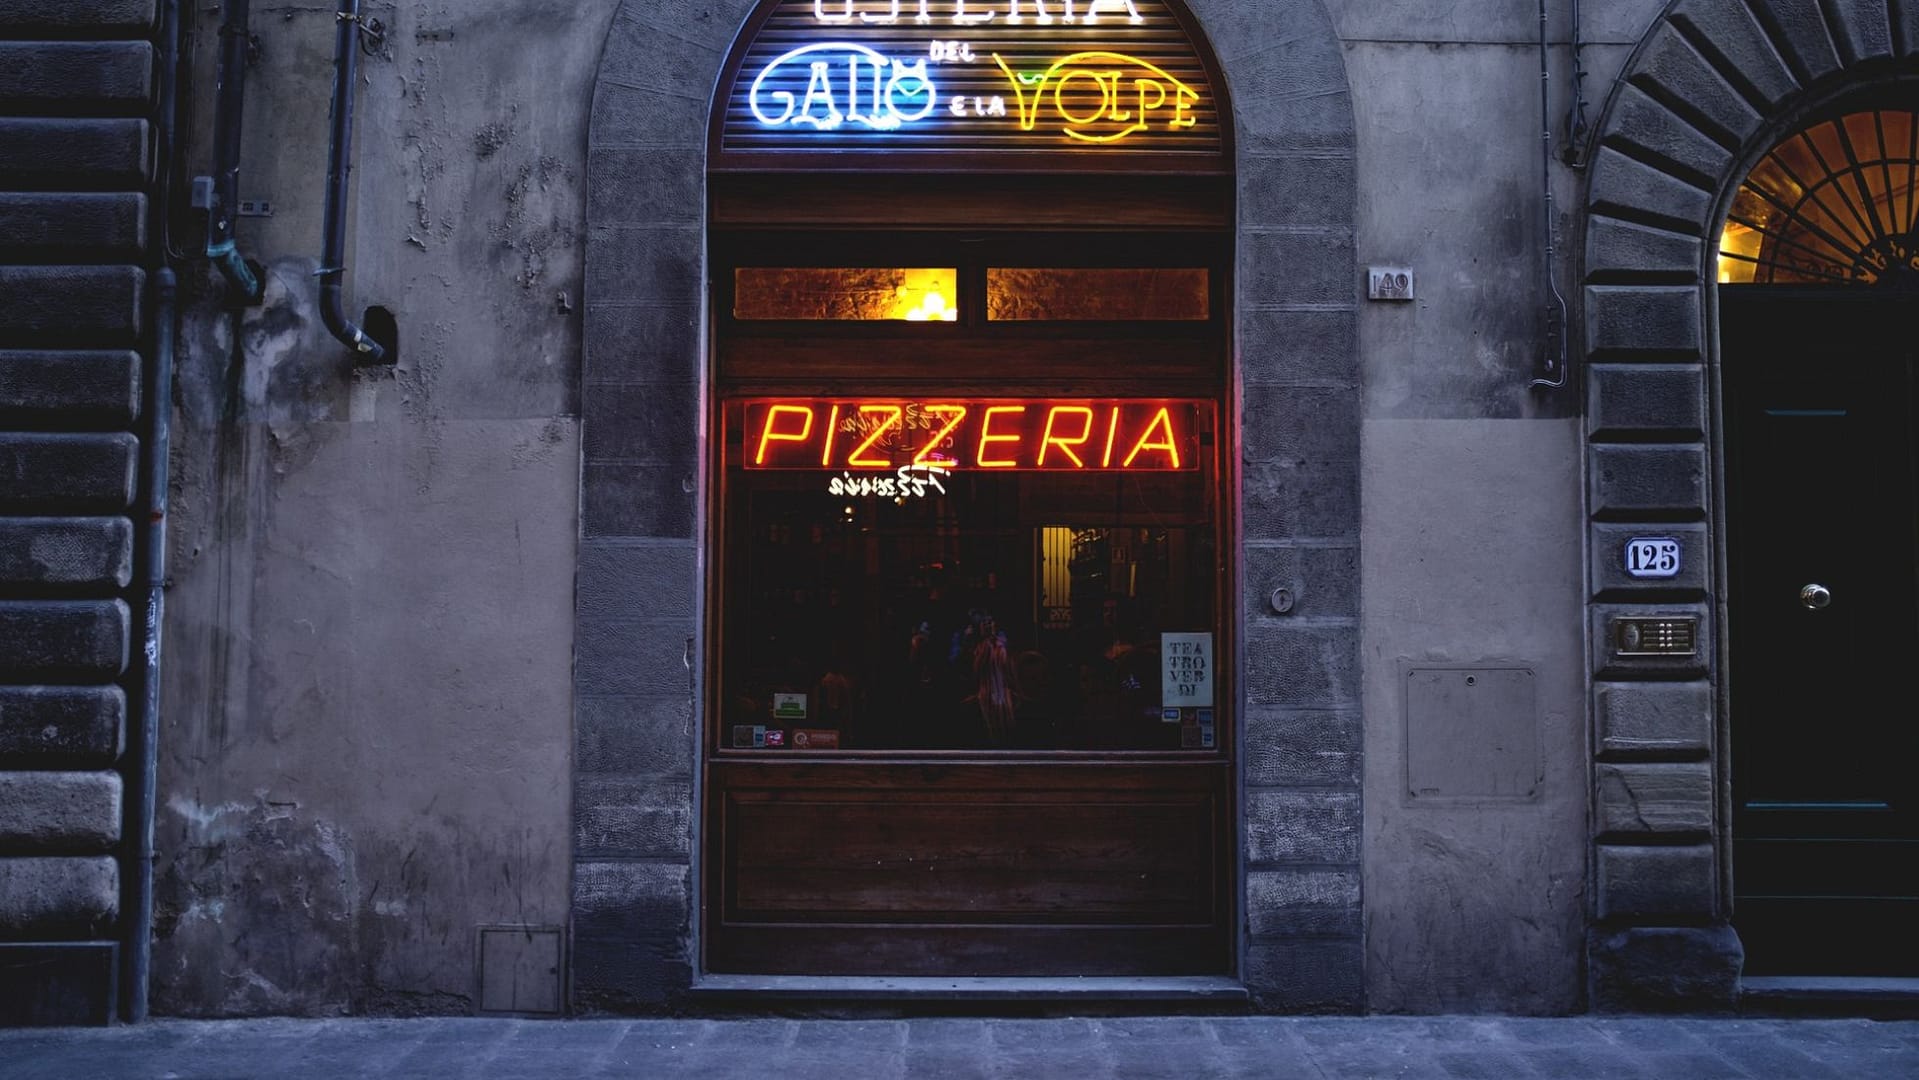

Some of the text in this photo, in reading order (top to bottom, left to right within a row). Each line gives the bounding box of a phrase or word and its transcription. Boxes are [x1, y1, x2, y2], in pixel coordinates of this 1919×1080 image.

[928, 40, 975, 62] DEL
[749, 42, 936, 129] GALLO
[992, 51, 1199, 131] VOLPE
[755, 405, 1181, 468] PIZZERIA
[1630, 544, 1676, 571] 125
[1169, 641, 1202, 655] TEA
[1169, 656, 1205, 669] TRO
[1169, 670, 1205, 683] VER
